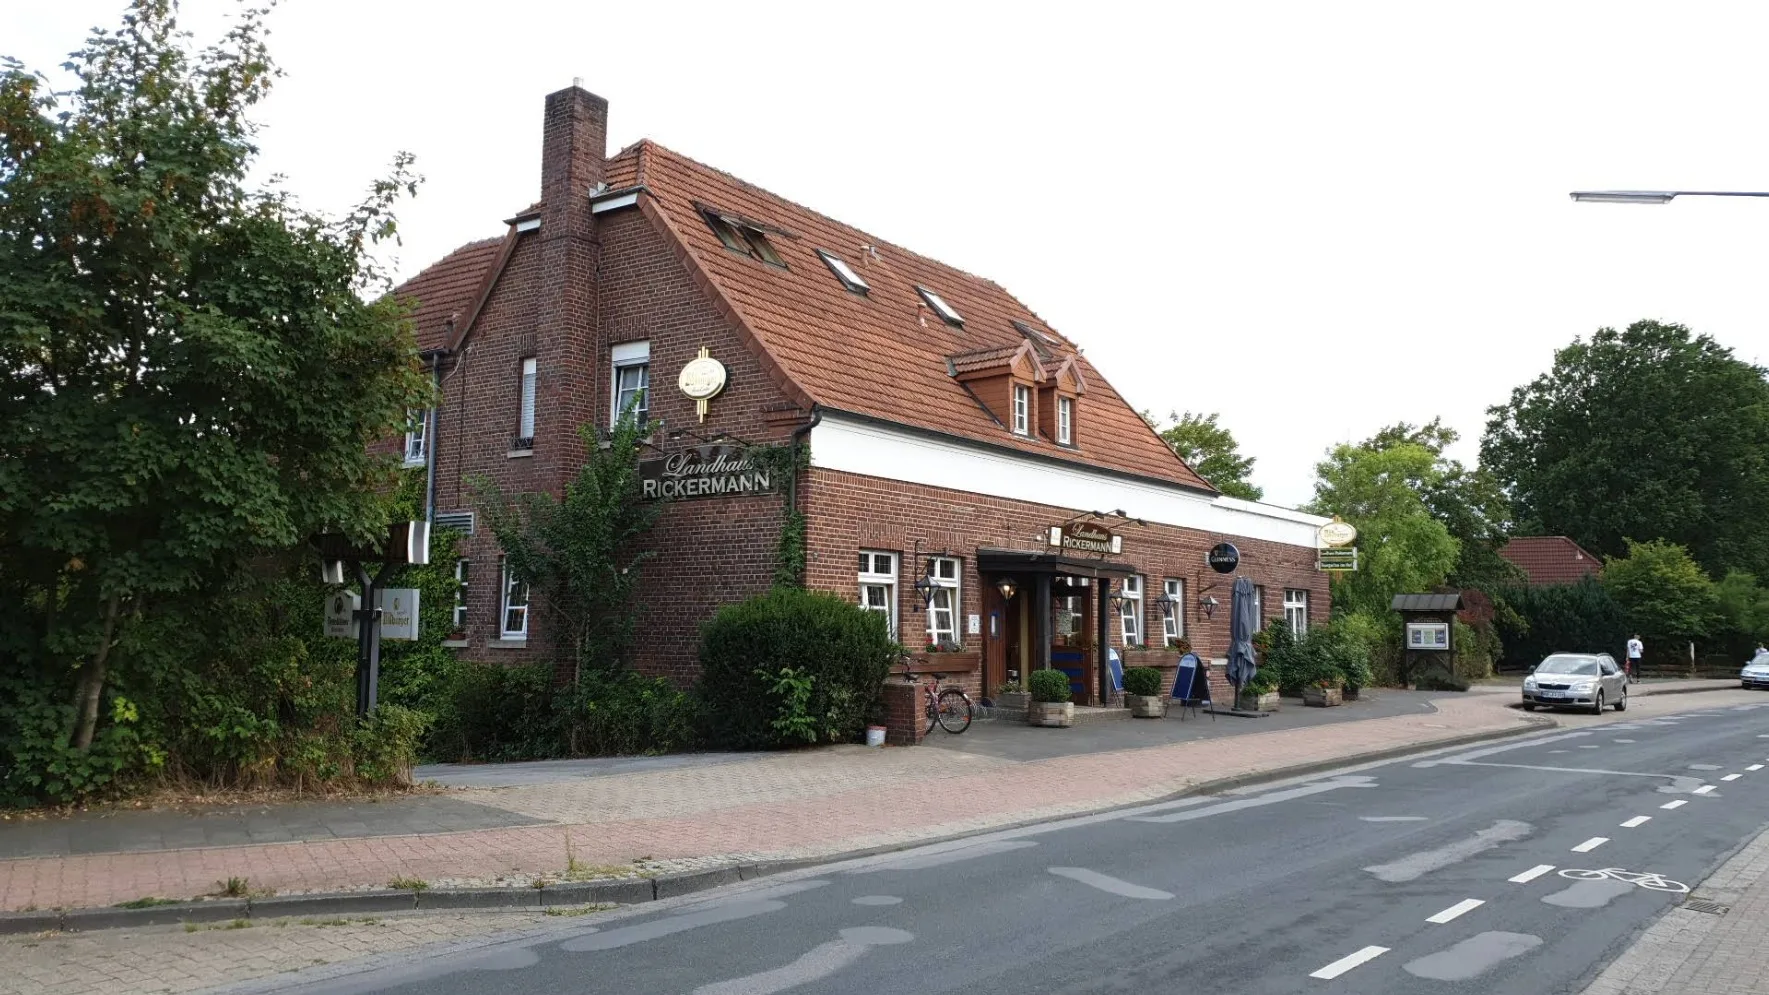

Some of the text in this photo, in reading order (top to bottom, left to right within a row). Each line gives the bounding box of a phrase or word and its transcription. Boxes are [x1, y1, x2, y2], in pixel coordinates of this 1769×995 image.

[661, 453, 755, 477] Landhaus
[643, 470, 771, 499] RICKERMANN
[1070, 523, 1108, 541] Landhaus
[1063, 535, 1112, 553] RICKERMANN
[1210, 555, 1236, 563] GUINNESS
